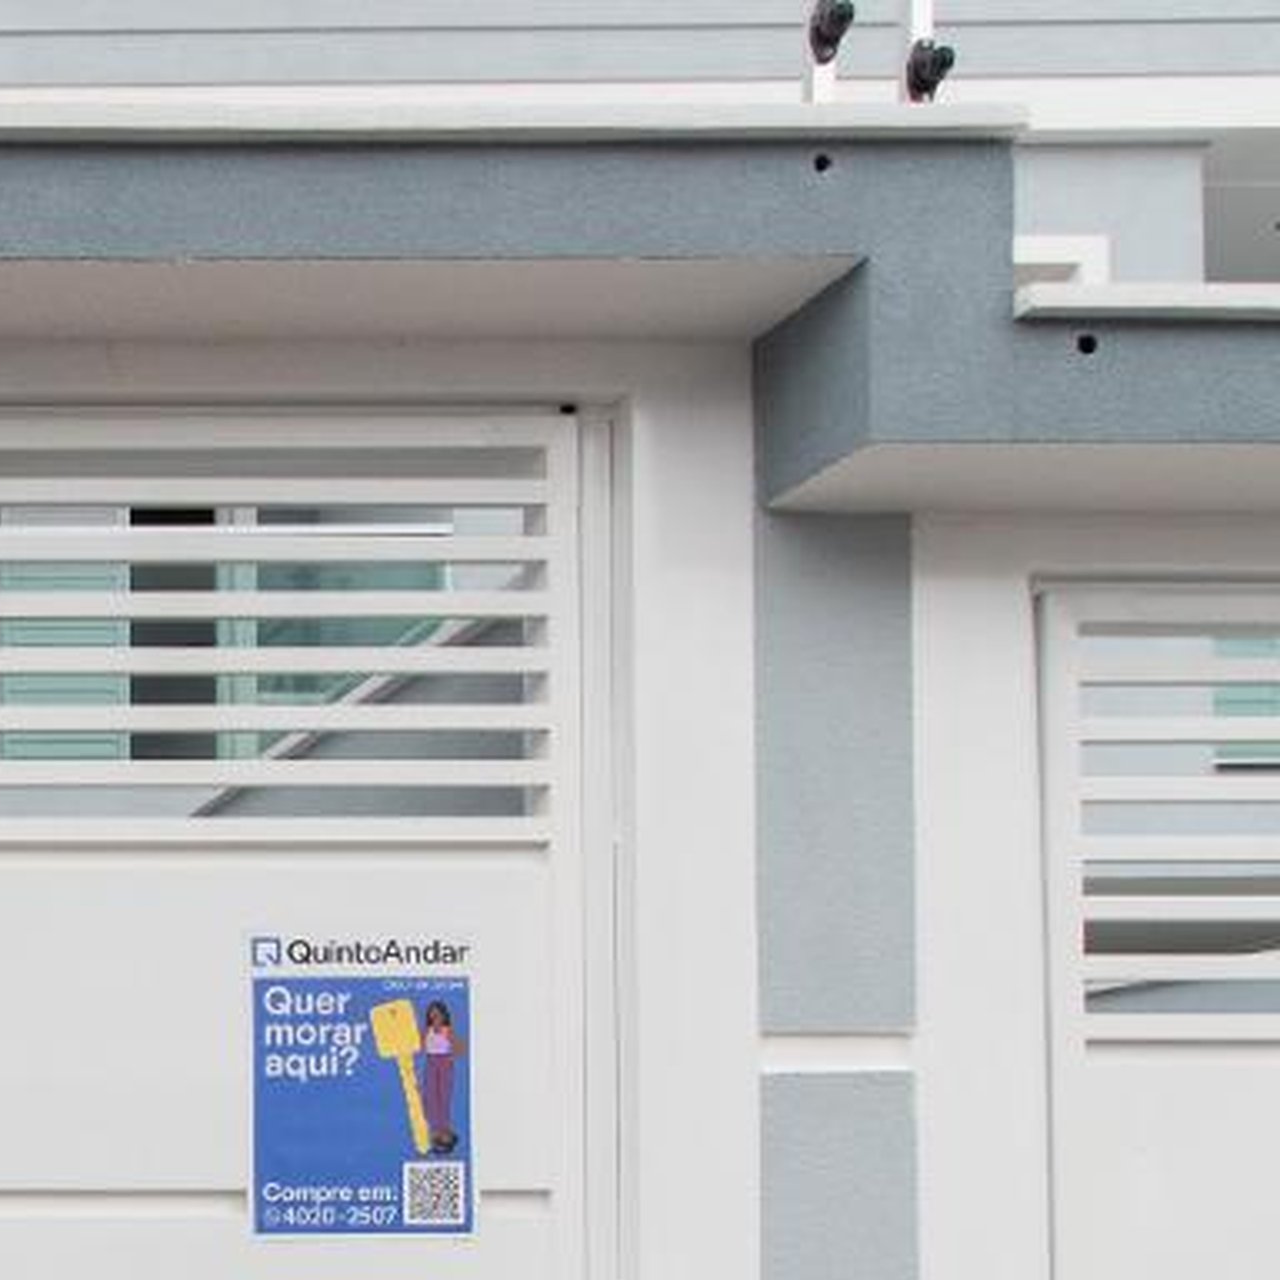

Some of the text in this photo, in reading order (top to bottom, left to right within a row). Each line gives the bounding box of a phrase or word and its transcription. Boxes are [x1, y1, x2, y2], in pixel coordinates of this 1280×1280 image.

[287, 939, 470, 966] QuintoAndar
[264, 986, 351, 1014] Quer
[265, 1022, 367, 1045] morar
[265, 1046, 360, 1081] aqui?
[262, 1182, 353, 1206] Compre
